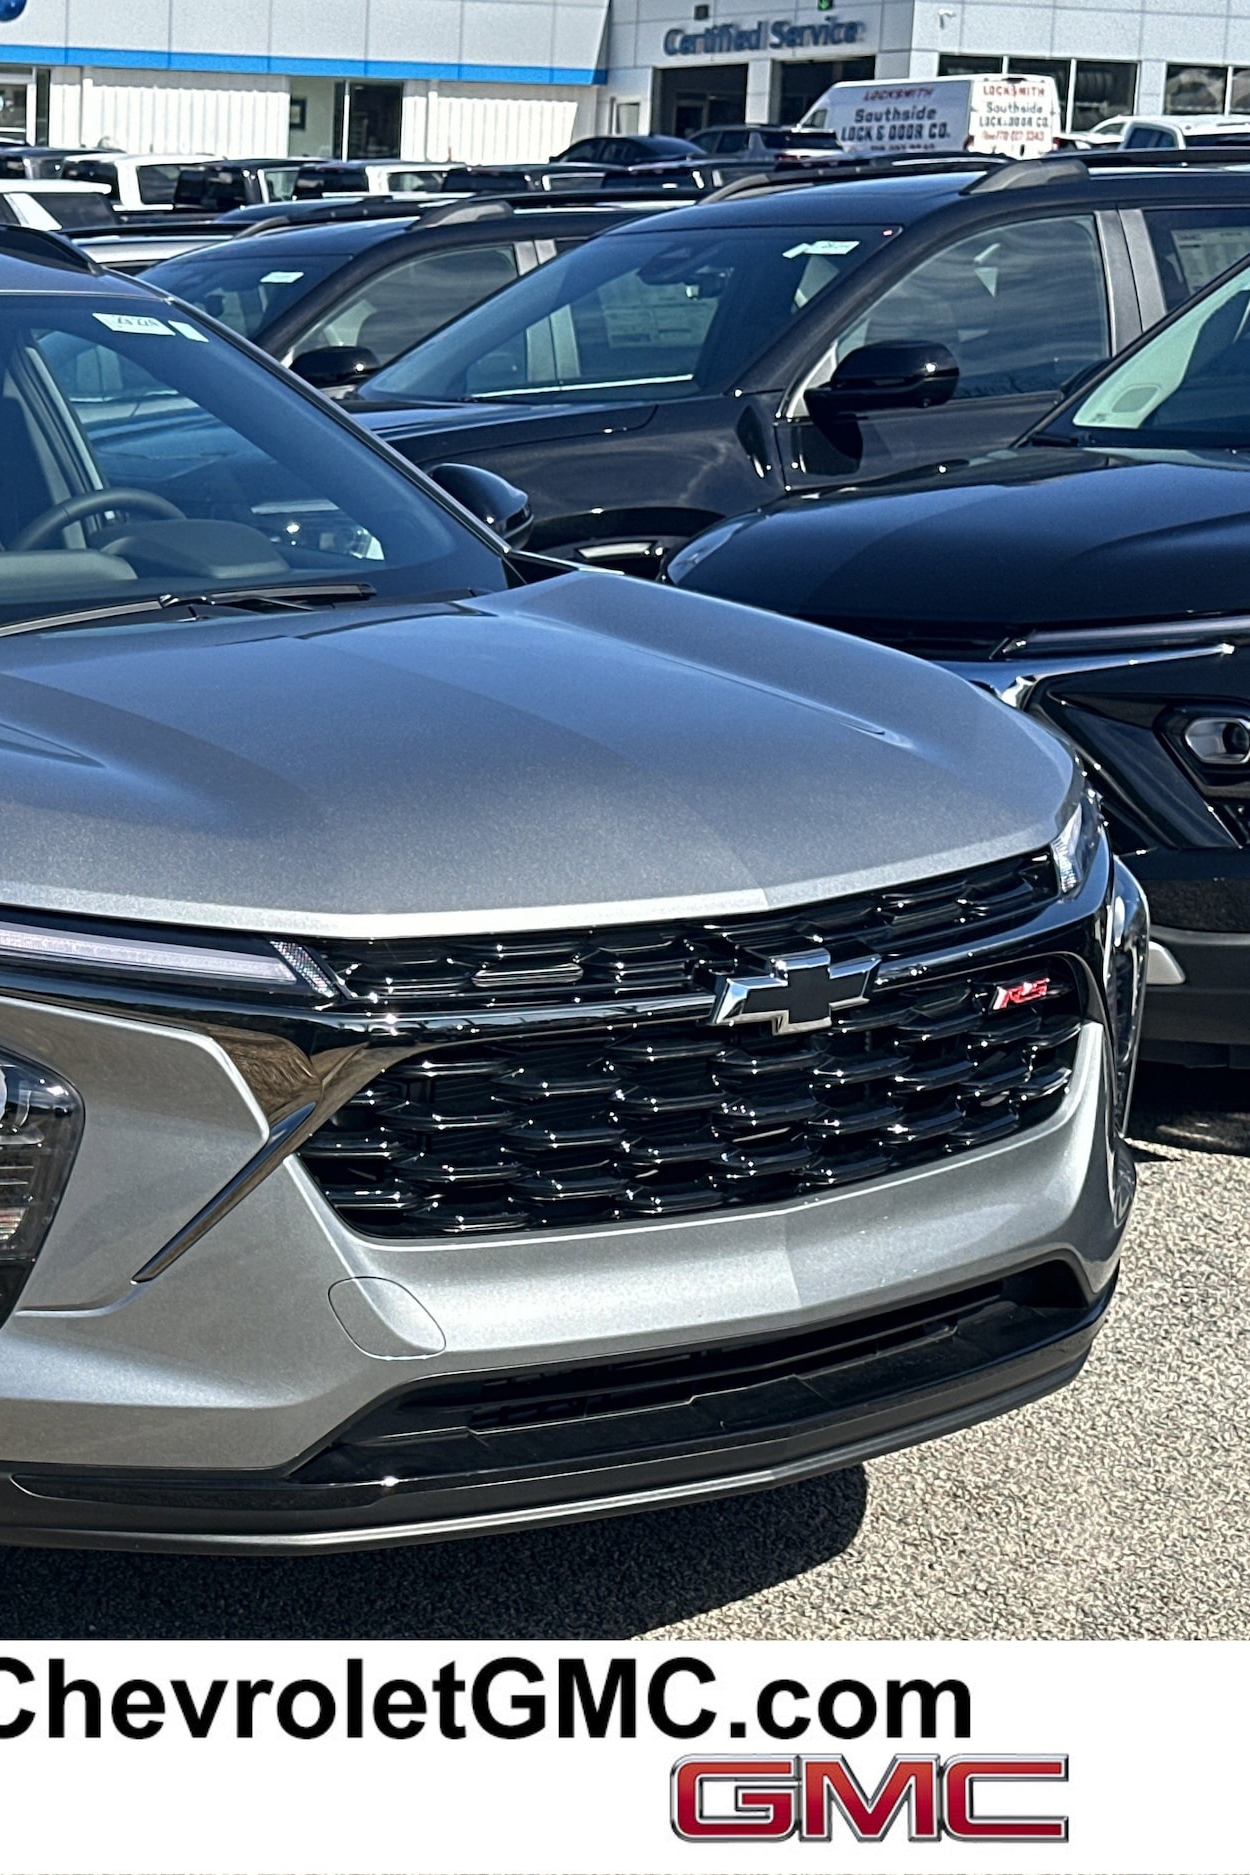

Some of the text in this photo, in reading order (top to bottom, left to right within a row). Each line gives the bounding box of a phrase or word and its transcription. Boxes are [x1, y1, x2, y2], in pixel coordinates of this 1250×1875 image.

[664, 16, 867, 55] Certified Service
[863, 87, 935, 101] LOCKSMITH
[983, 85, 1045, 97] LOCKSMITH
[854, 105, 937, 123] Southside
[986, 101, 1043, 114] Southside
[840, 126, 872, 142] LOCK
[888, 123, 924, 140] DOOR
[992, 978, 1050, 1010] RS
